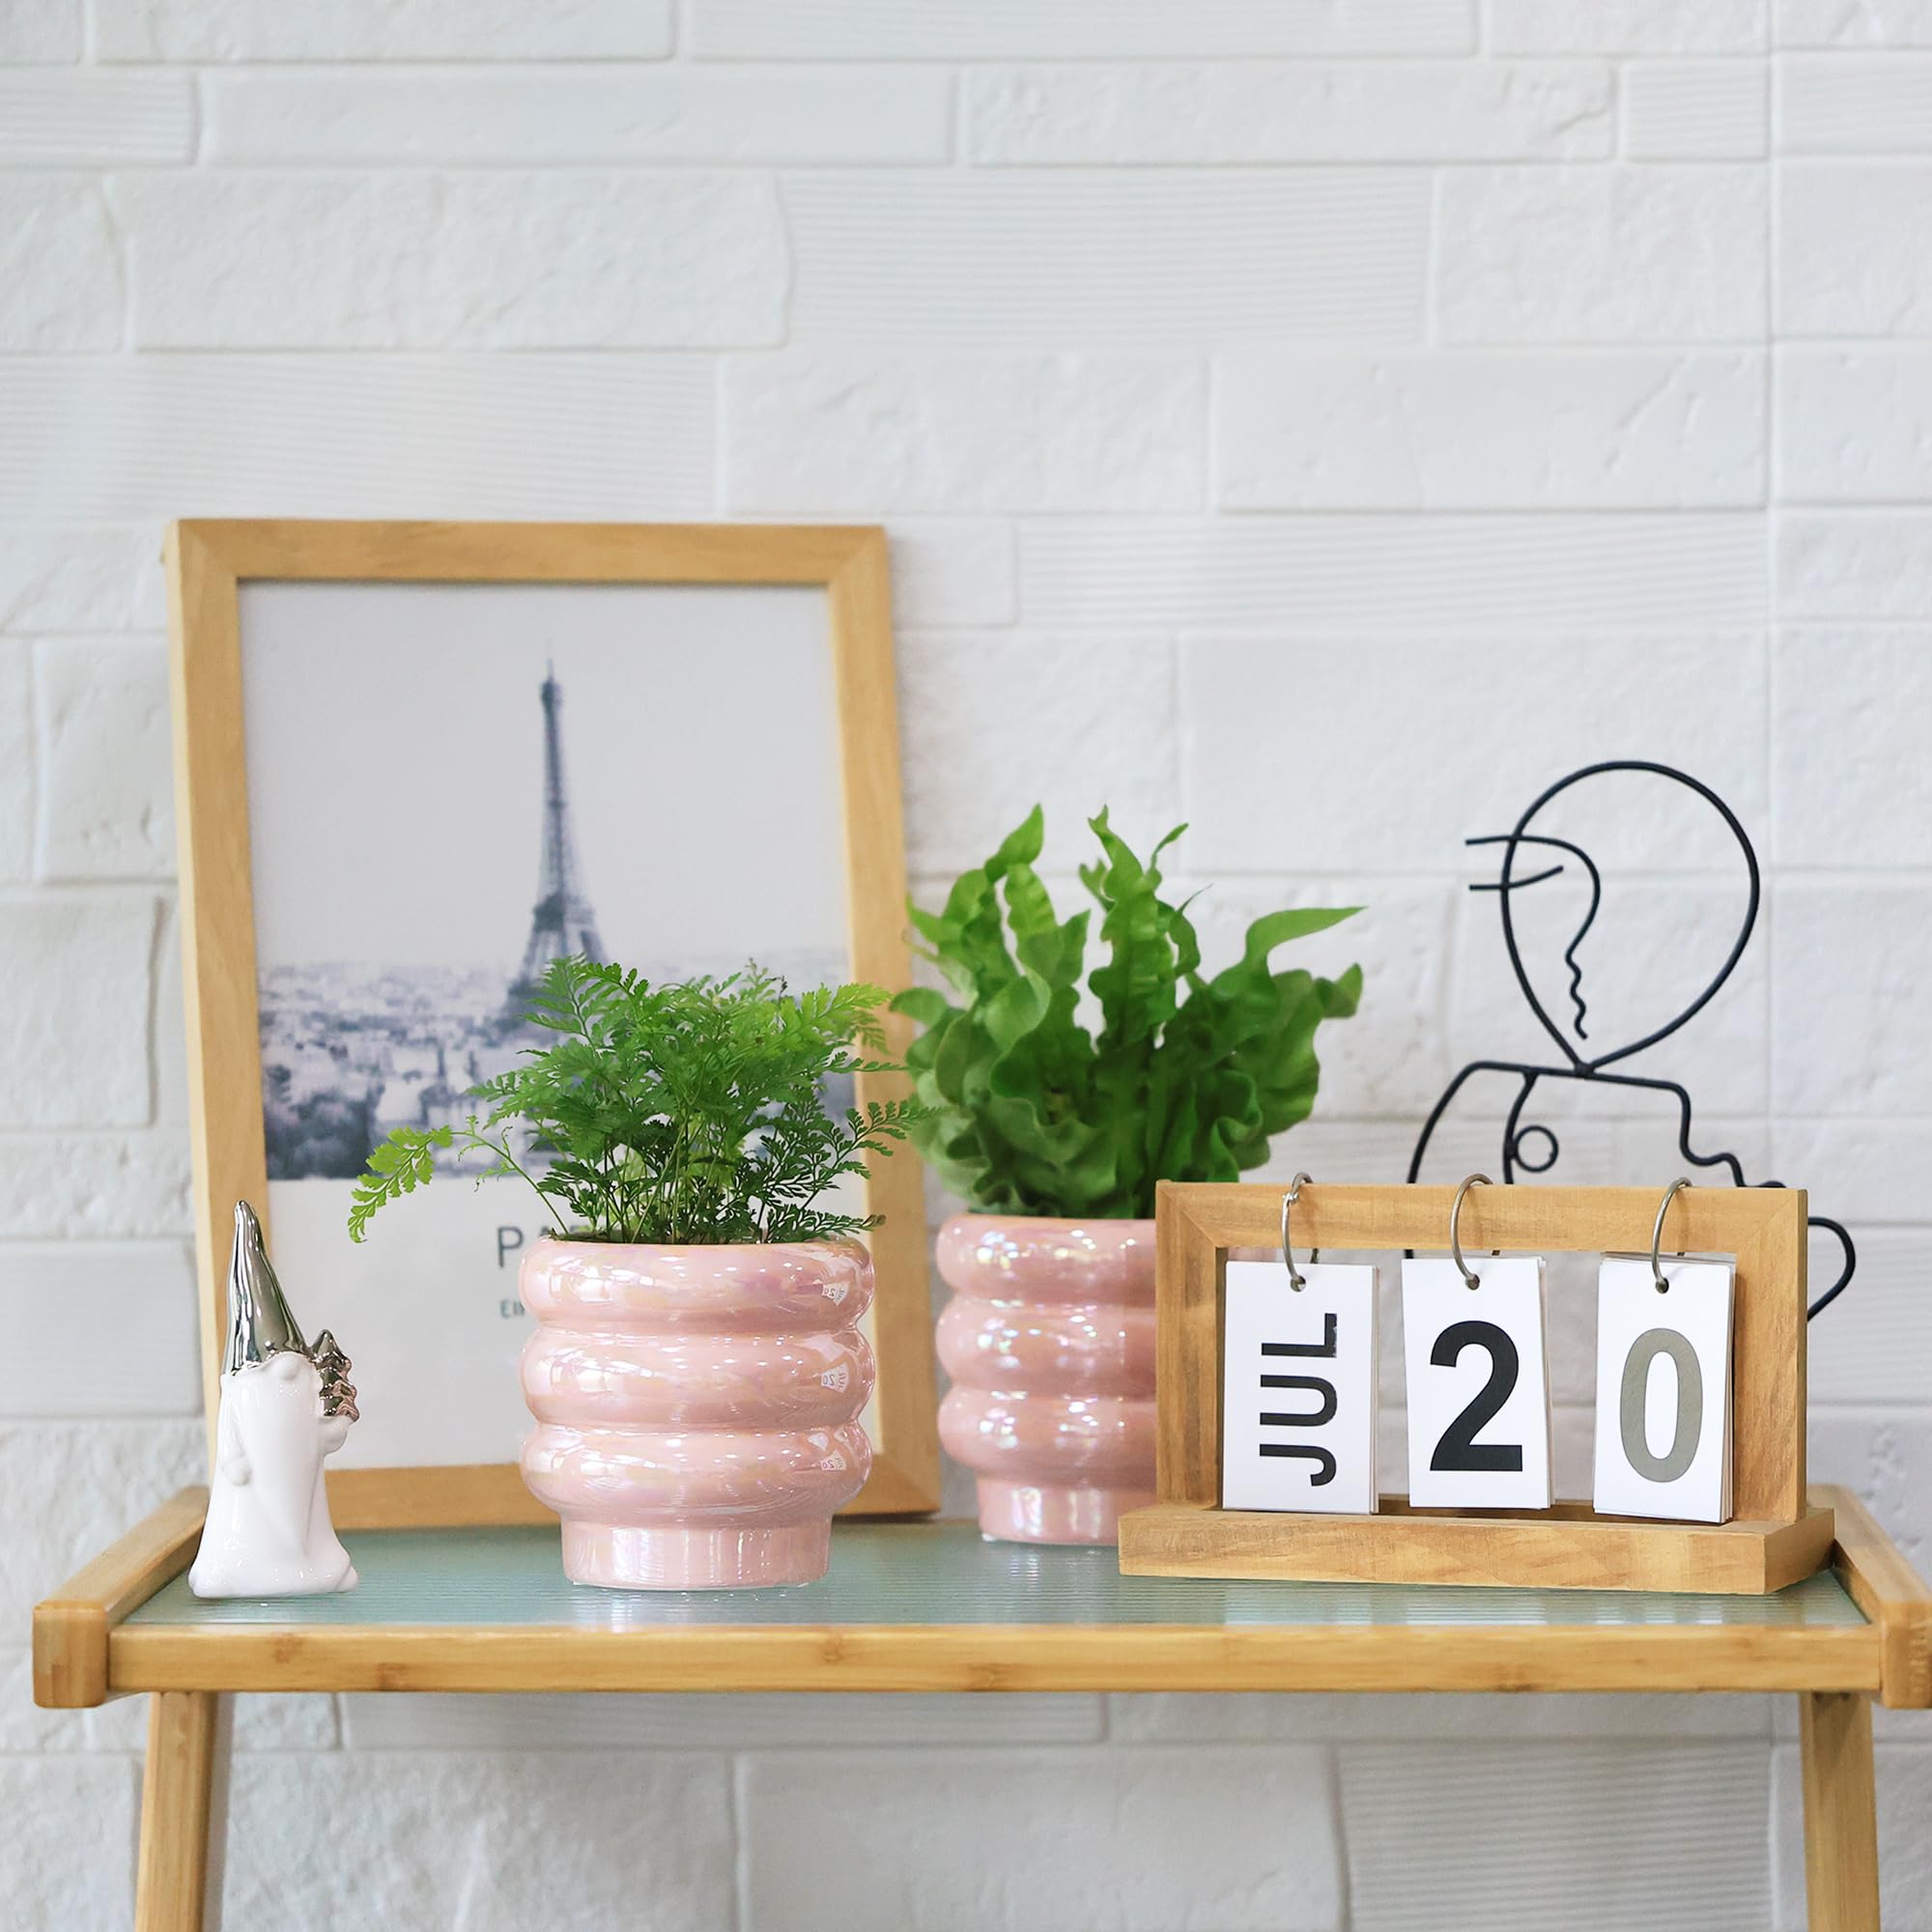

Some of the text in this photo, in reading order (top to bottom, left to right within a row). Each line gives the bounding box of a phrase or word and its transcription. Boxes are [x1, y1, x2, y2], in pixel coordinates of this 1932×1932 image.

[1259, 1312, 1338, 1488] JUL
[1429, 1320, 1523, 1472] 2
[1619, 1327, 1704, 1484] 0
